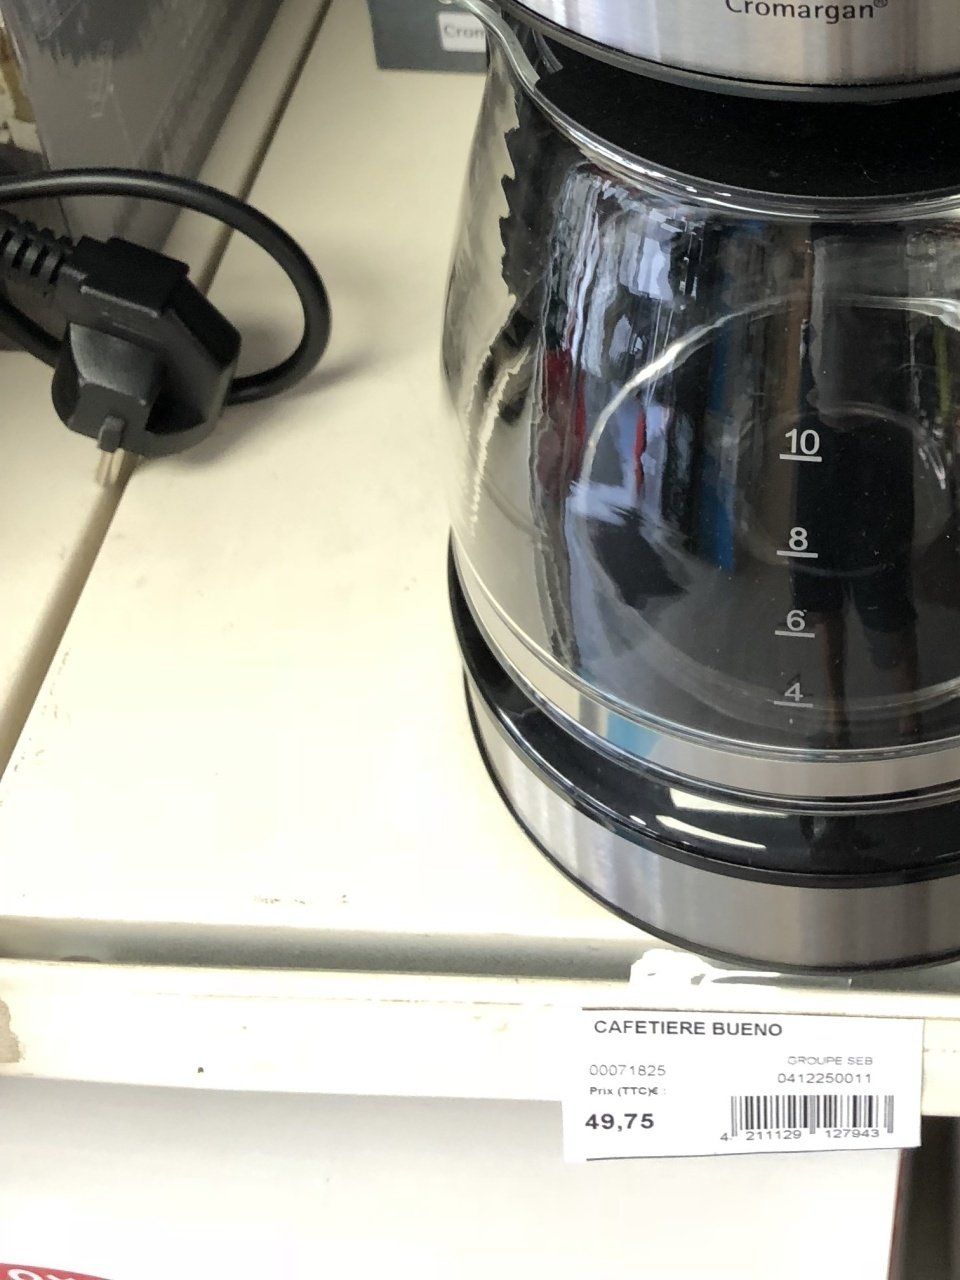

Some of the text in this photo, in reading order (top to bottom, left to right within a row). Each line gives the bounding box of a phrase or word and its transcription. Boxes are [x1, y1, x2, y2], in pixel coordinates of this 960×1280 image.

[785, 428, 820, 455] 10
[788, 526, 808, 551] 8
[786, 609, 806, 631] 6
[784, 682, 804, 702] 4
[594, 1020, 783, 1037] CAFETIERE BUENO
[787, 1056, 873, 1066] GROUPE SEB
[589, 1064, 666, 1077] 00071825
[777, 1073, 872, 1084] 0412250011
[589, 1086, 614, 1096] Prix
[585, 1113, 655, 1132] 49,75
[720, 1129, 880, 1142] 4 211129 127943
